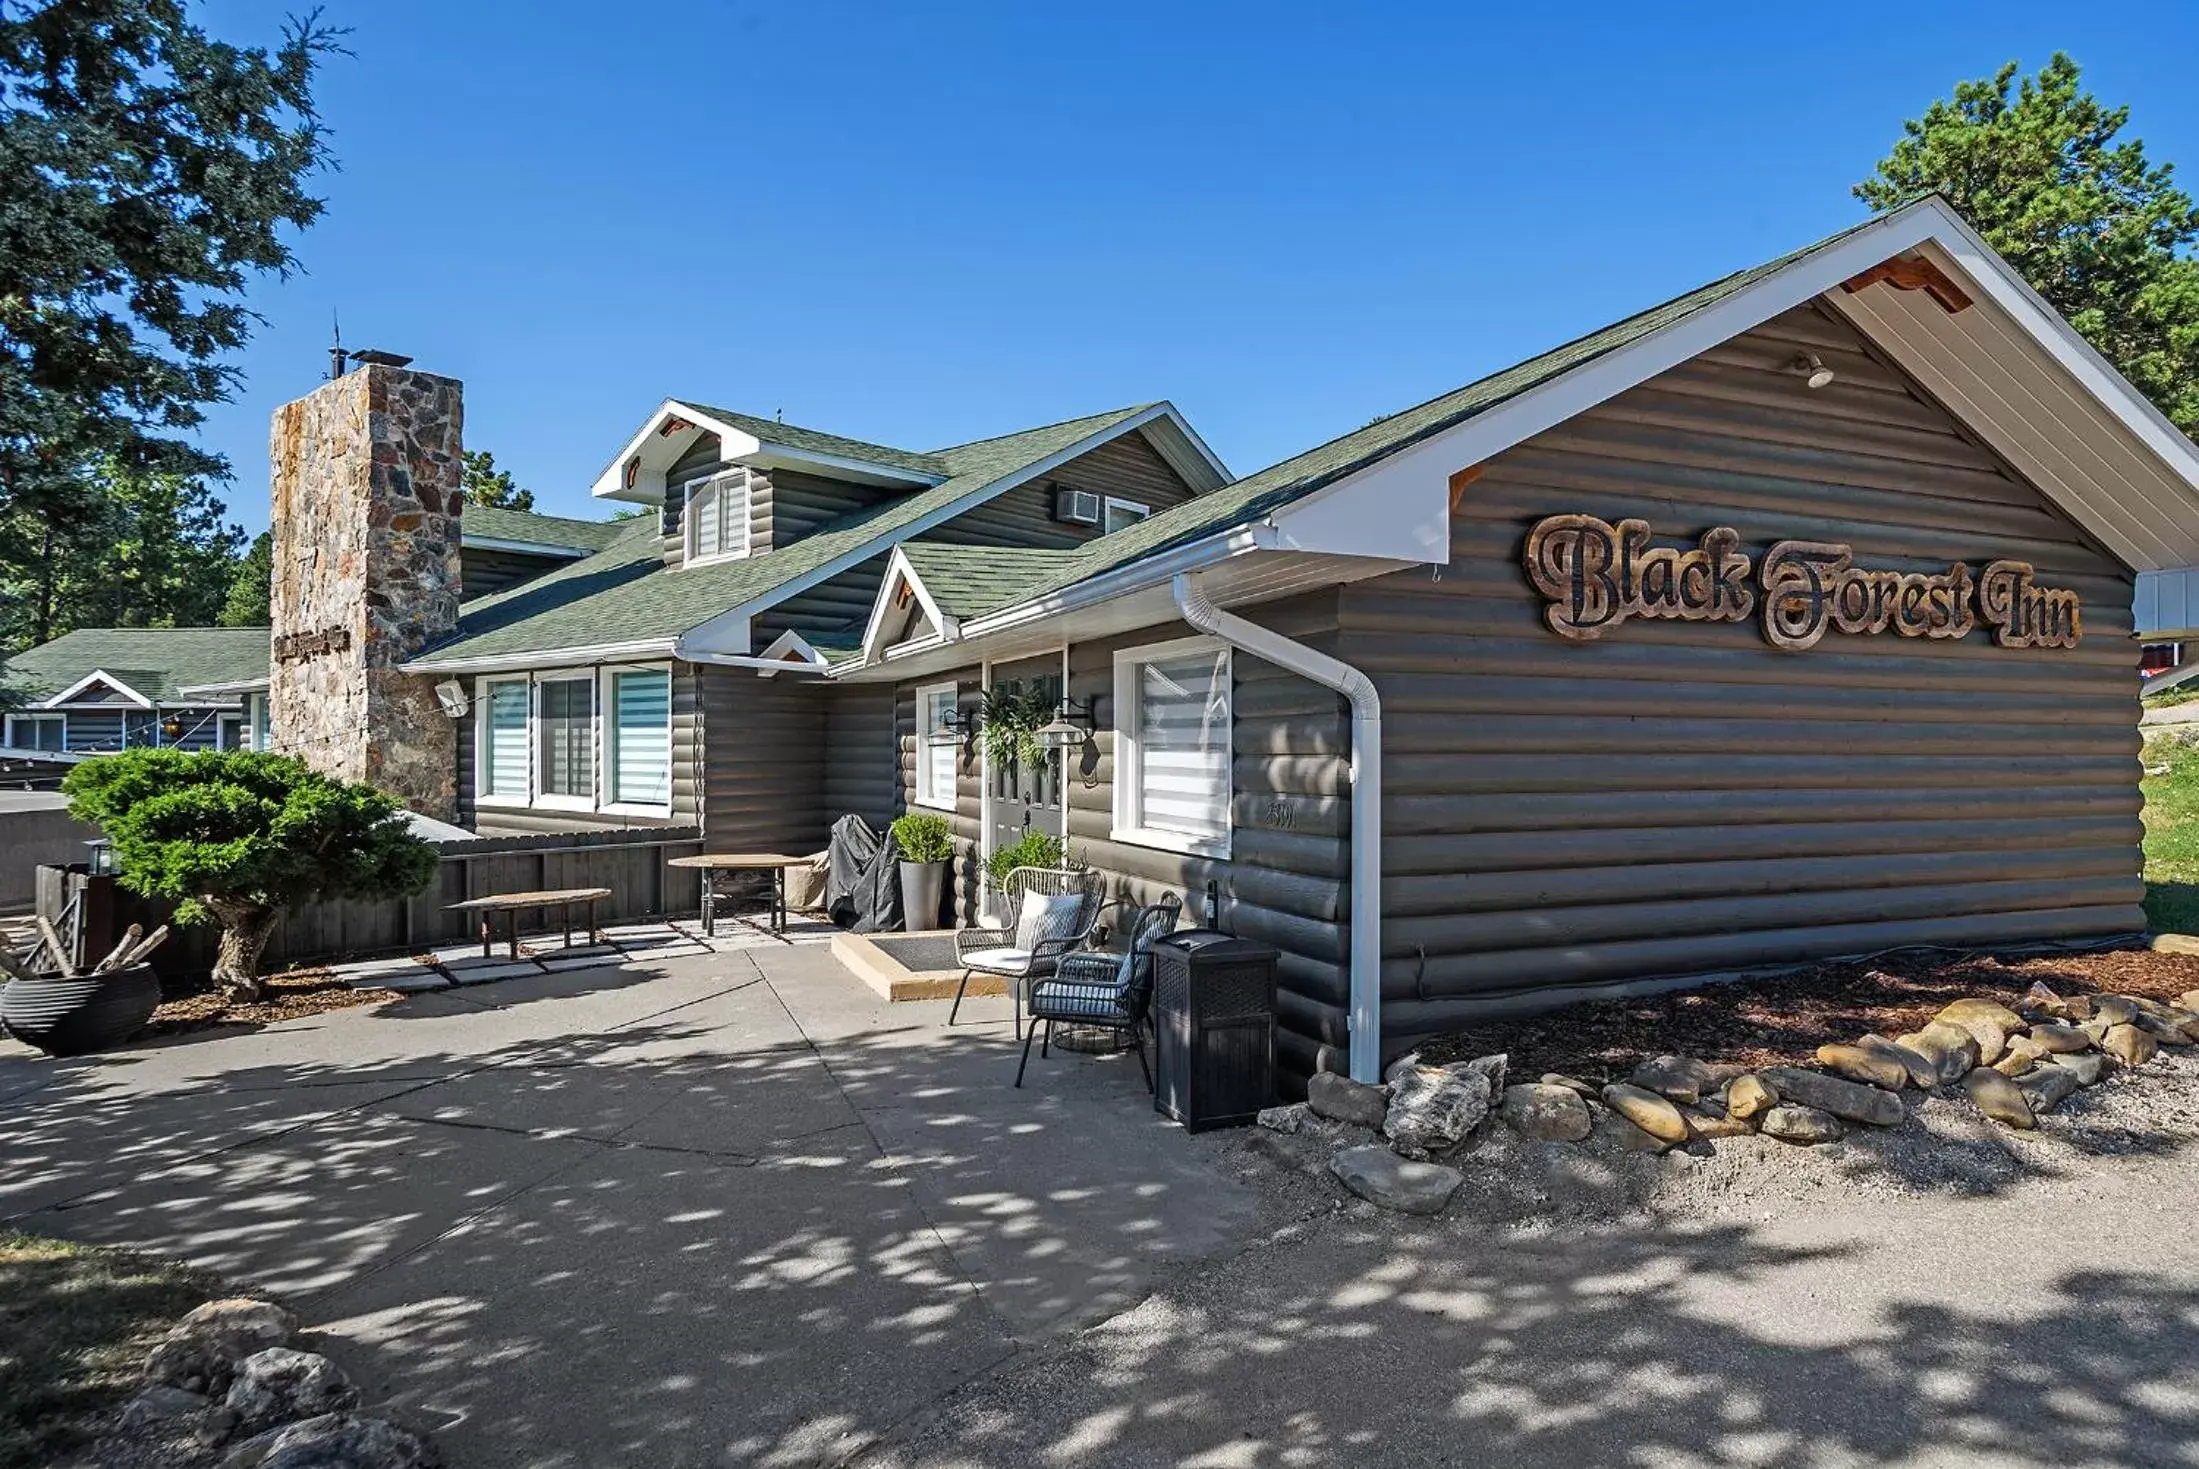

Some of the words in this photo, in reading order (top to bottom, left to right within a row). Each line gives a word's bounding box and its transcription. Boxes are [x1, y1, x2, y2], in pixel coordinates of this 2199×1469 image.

[1534, 521, 1750, 632] Black
[1768, 548, 1970, 643] Forest
[1986, 566, 2077, 641] Inn
